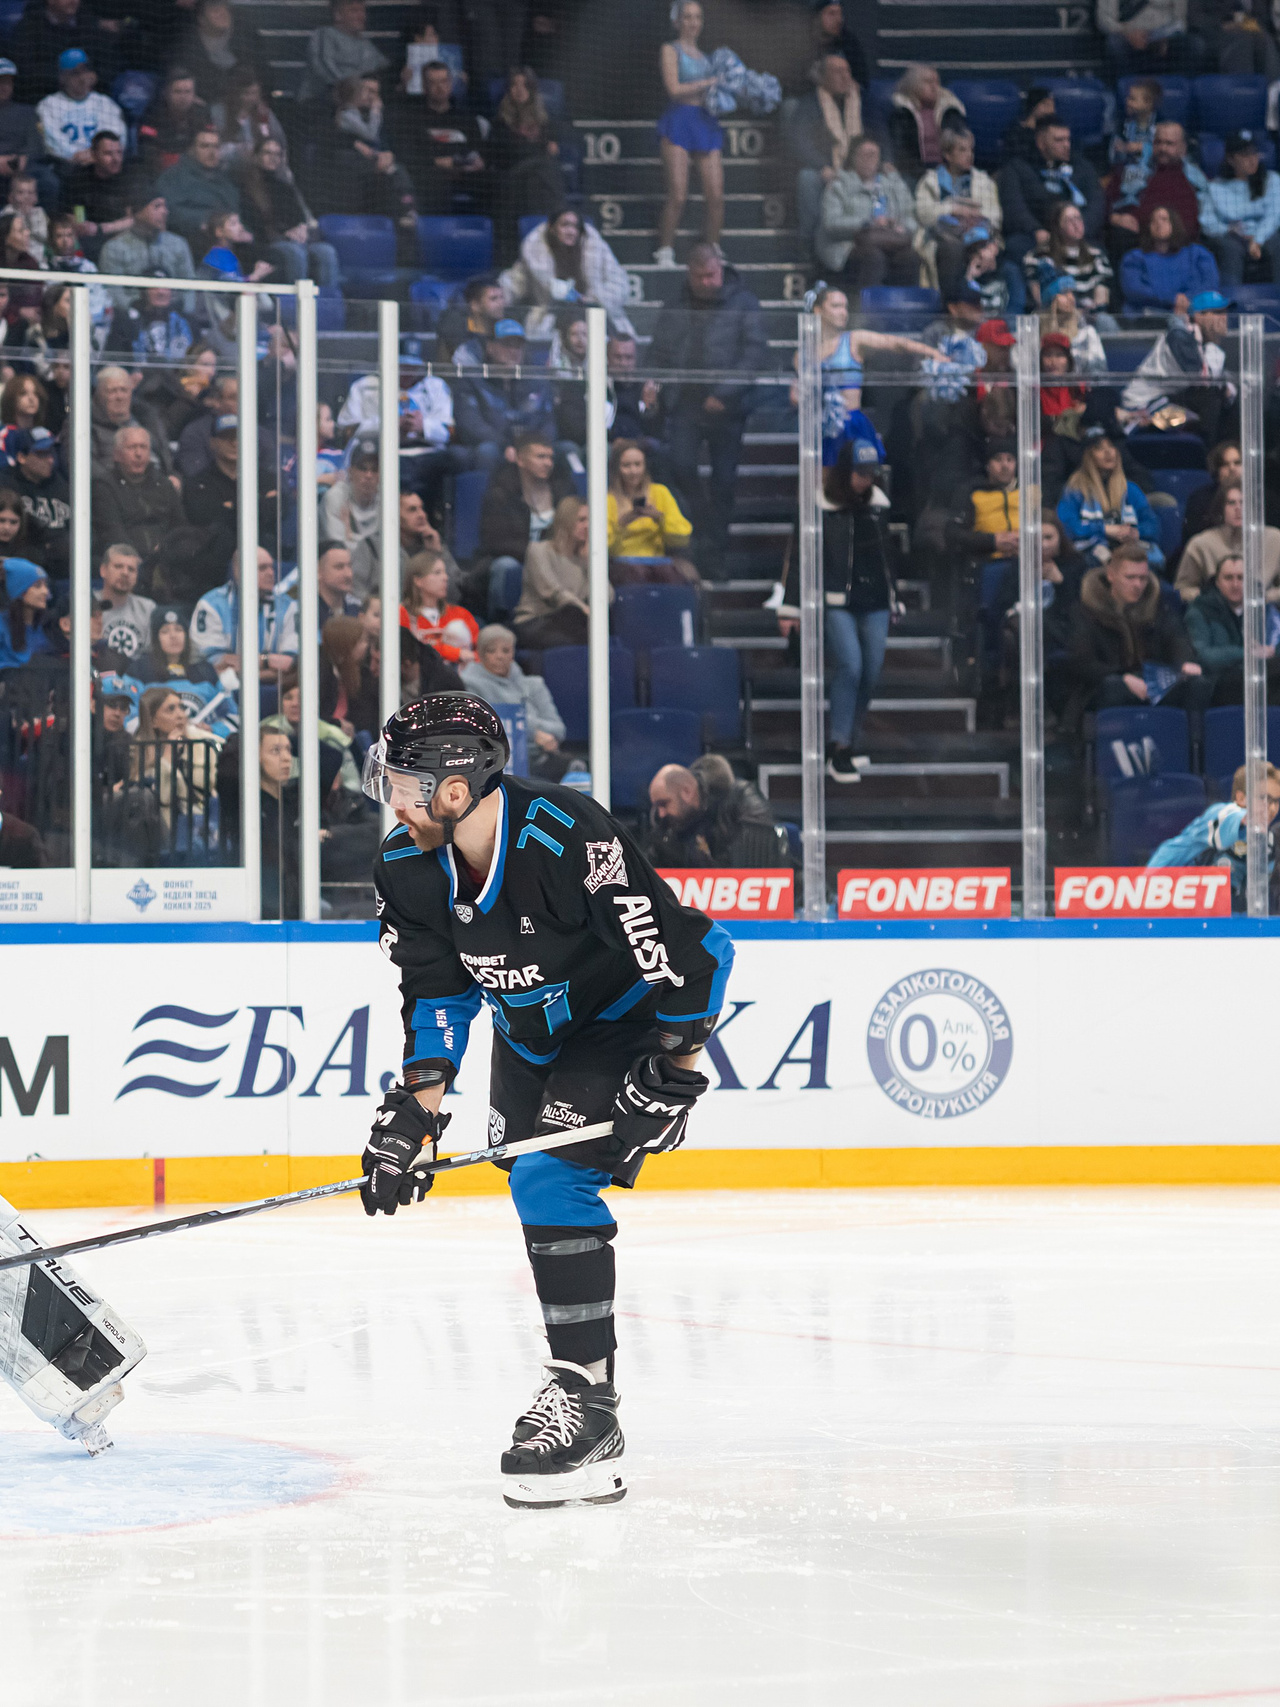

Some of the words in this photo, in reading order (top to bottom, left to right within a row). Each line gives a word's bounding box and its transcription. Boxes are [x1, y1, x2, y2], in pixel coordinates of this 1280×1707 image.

[584, 133, 620, 161] 10
[727, 128, 764, 156] 10
[600, 202, 624, 229] 9
[445, 757, 475, 767] CCM
[662, 876, 791, 912] ONBET
[840, 876, 1009, 912] FONBET
[1058, 875, 1228, 910] FONBET
[460, 952, 507, 967] FONBET
[869, 971, 1010, 1041] БЕЗАЛКОГОЛЬНАЯ
[942, 1018, 978, 1035] Алк.
[883, 1070, 999, 1120] ПРОДУКЦИЯ
